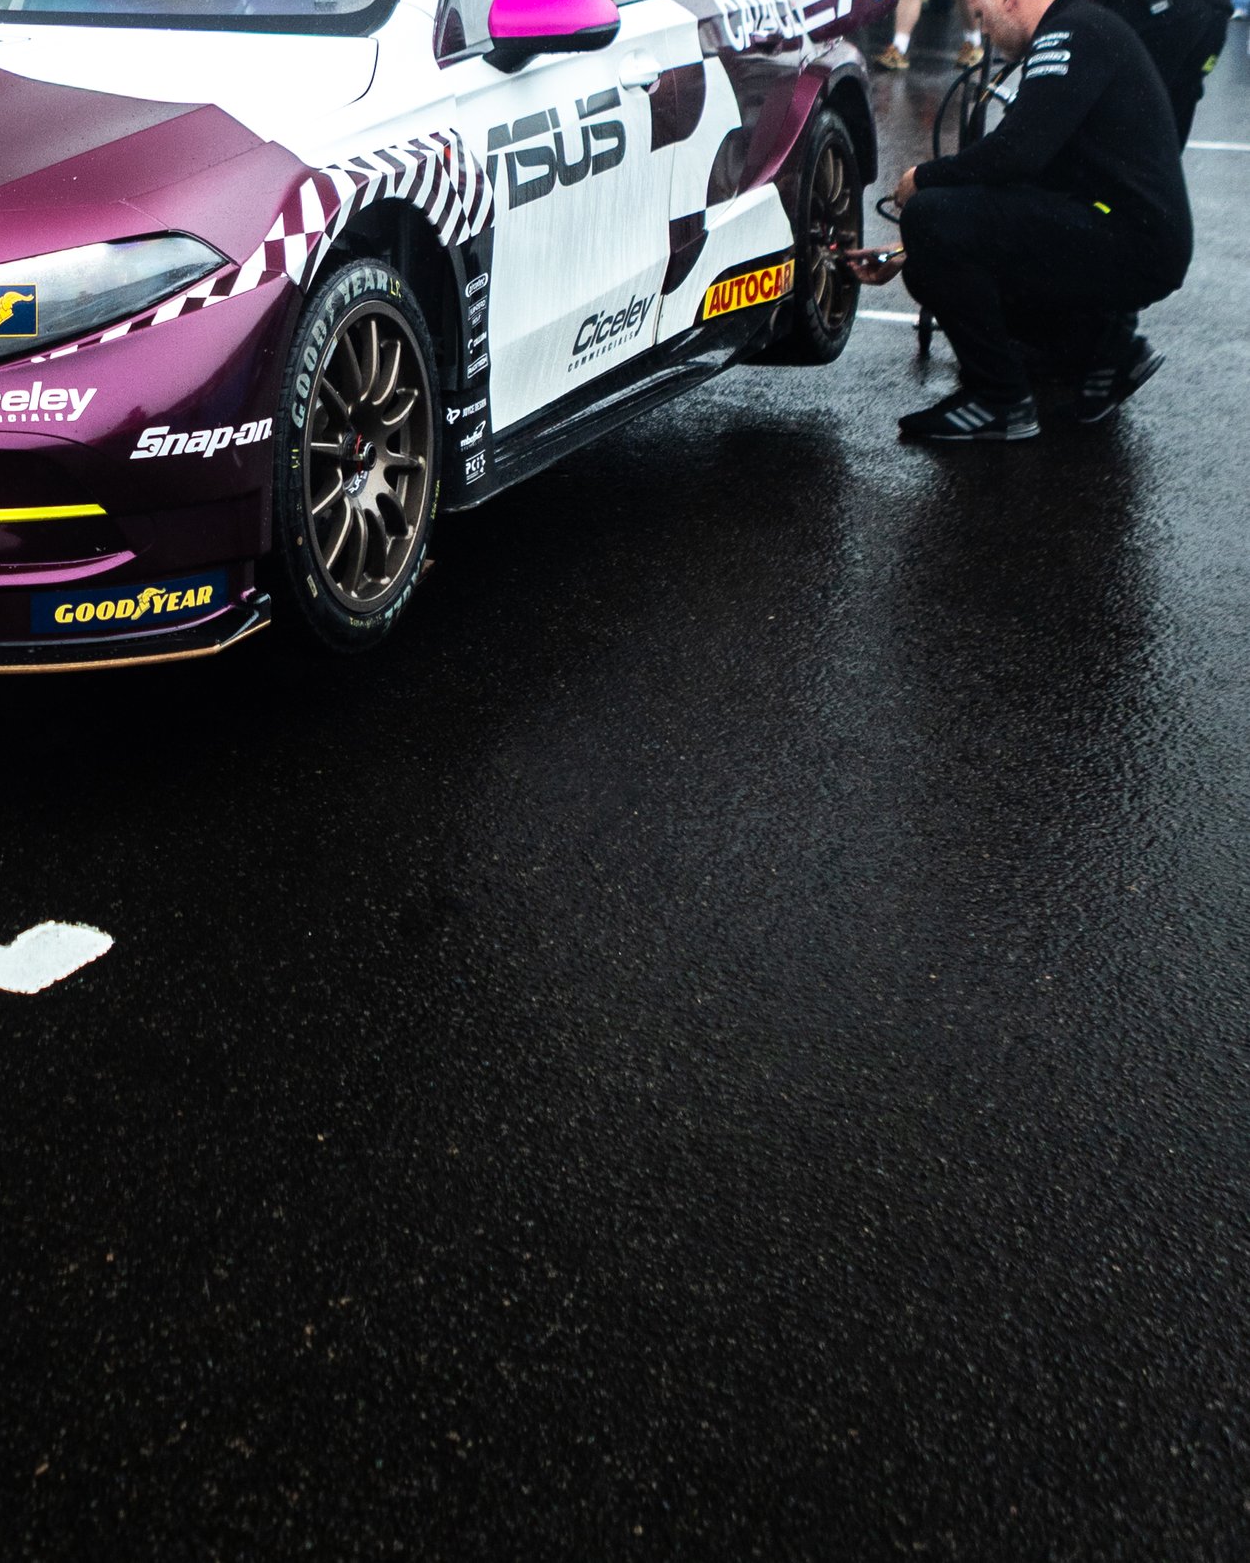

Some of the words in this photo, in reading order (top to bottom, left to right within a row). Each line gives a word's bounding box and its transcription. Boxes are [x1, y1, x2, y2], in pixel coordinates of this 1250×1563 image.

[485, 86, 626, 211] ASUS
[707, 263, 791, 317] AUTOCAR
[568, 331, 633, 372] COMMERCIALS
[572, 293, 656, 356] Ciceley
[130, 417, 273, 460] Snap-on
